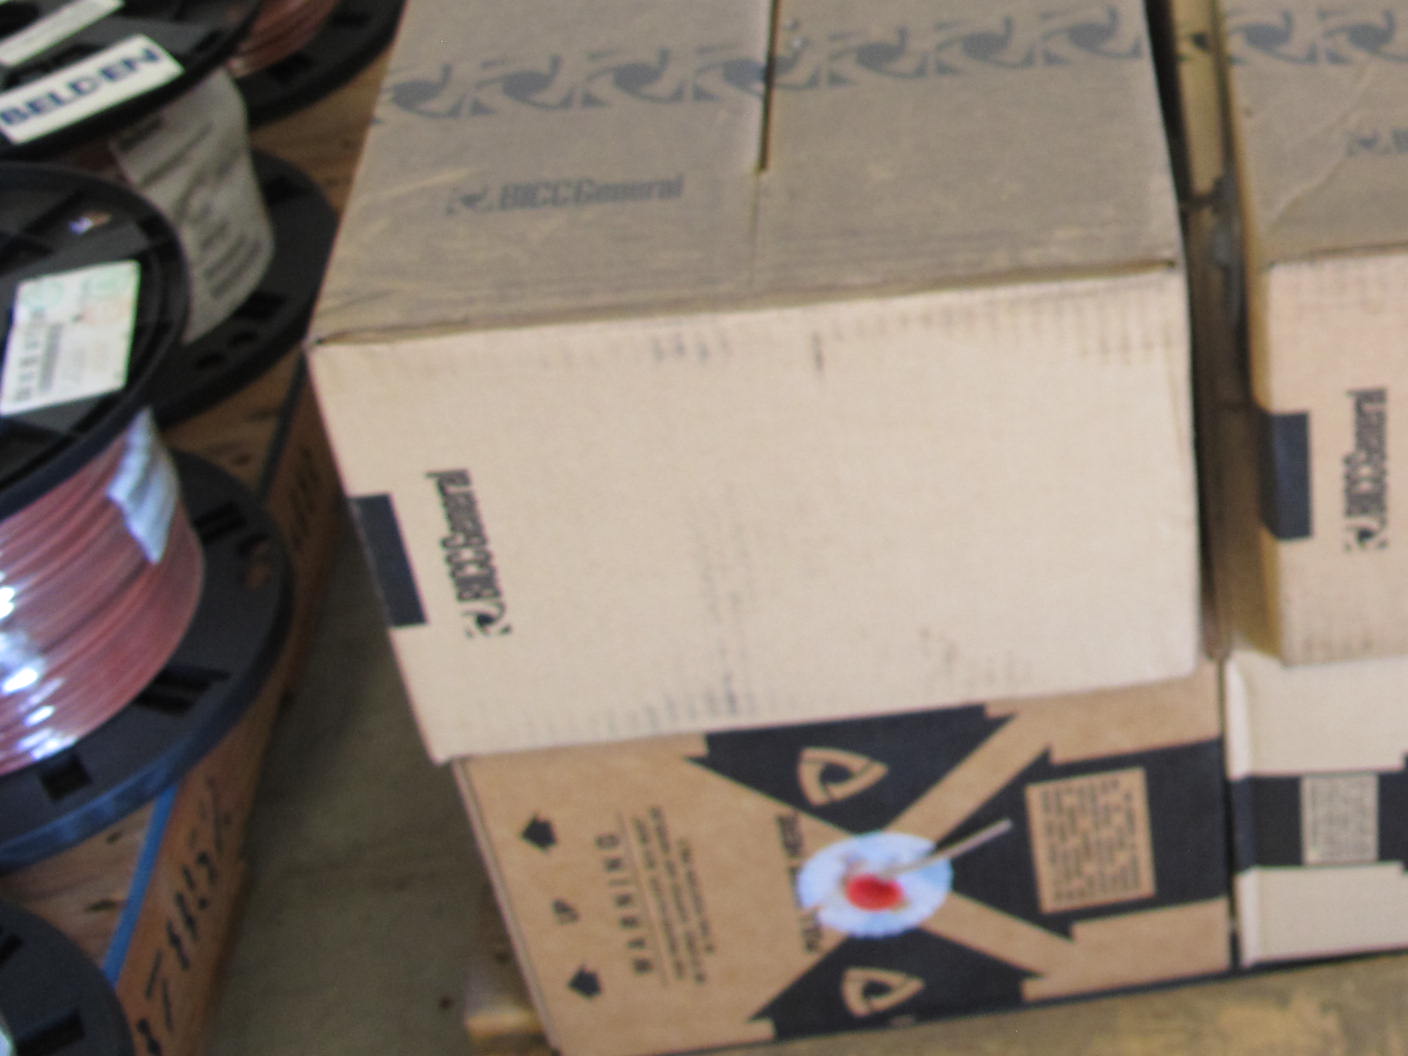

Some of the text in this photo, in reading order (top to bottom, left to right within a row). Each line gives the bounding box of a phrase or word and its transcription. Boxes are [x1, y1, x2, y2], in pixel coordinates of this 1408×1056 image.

[0, 48, 160, 124] BELDEN
[424, 468, 506, 618] BICCGeneral
[594, 833, 653, 975] WARNING
